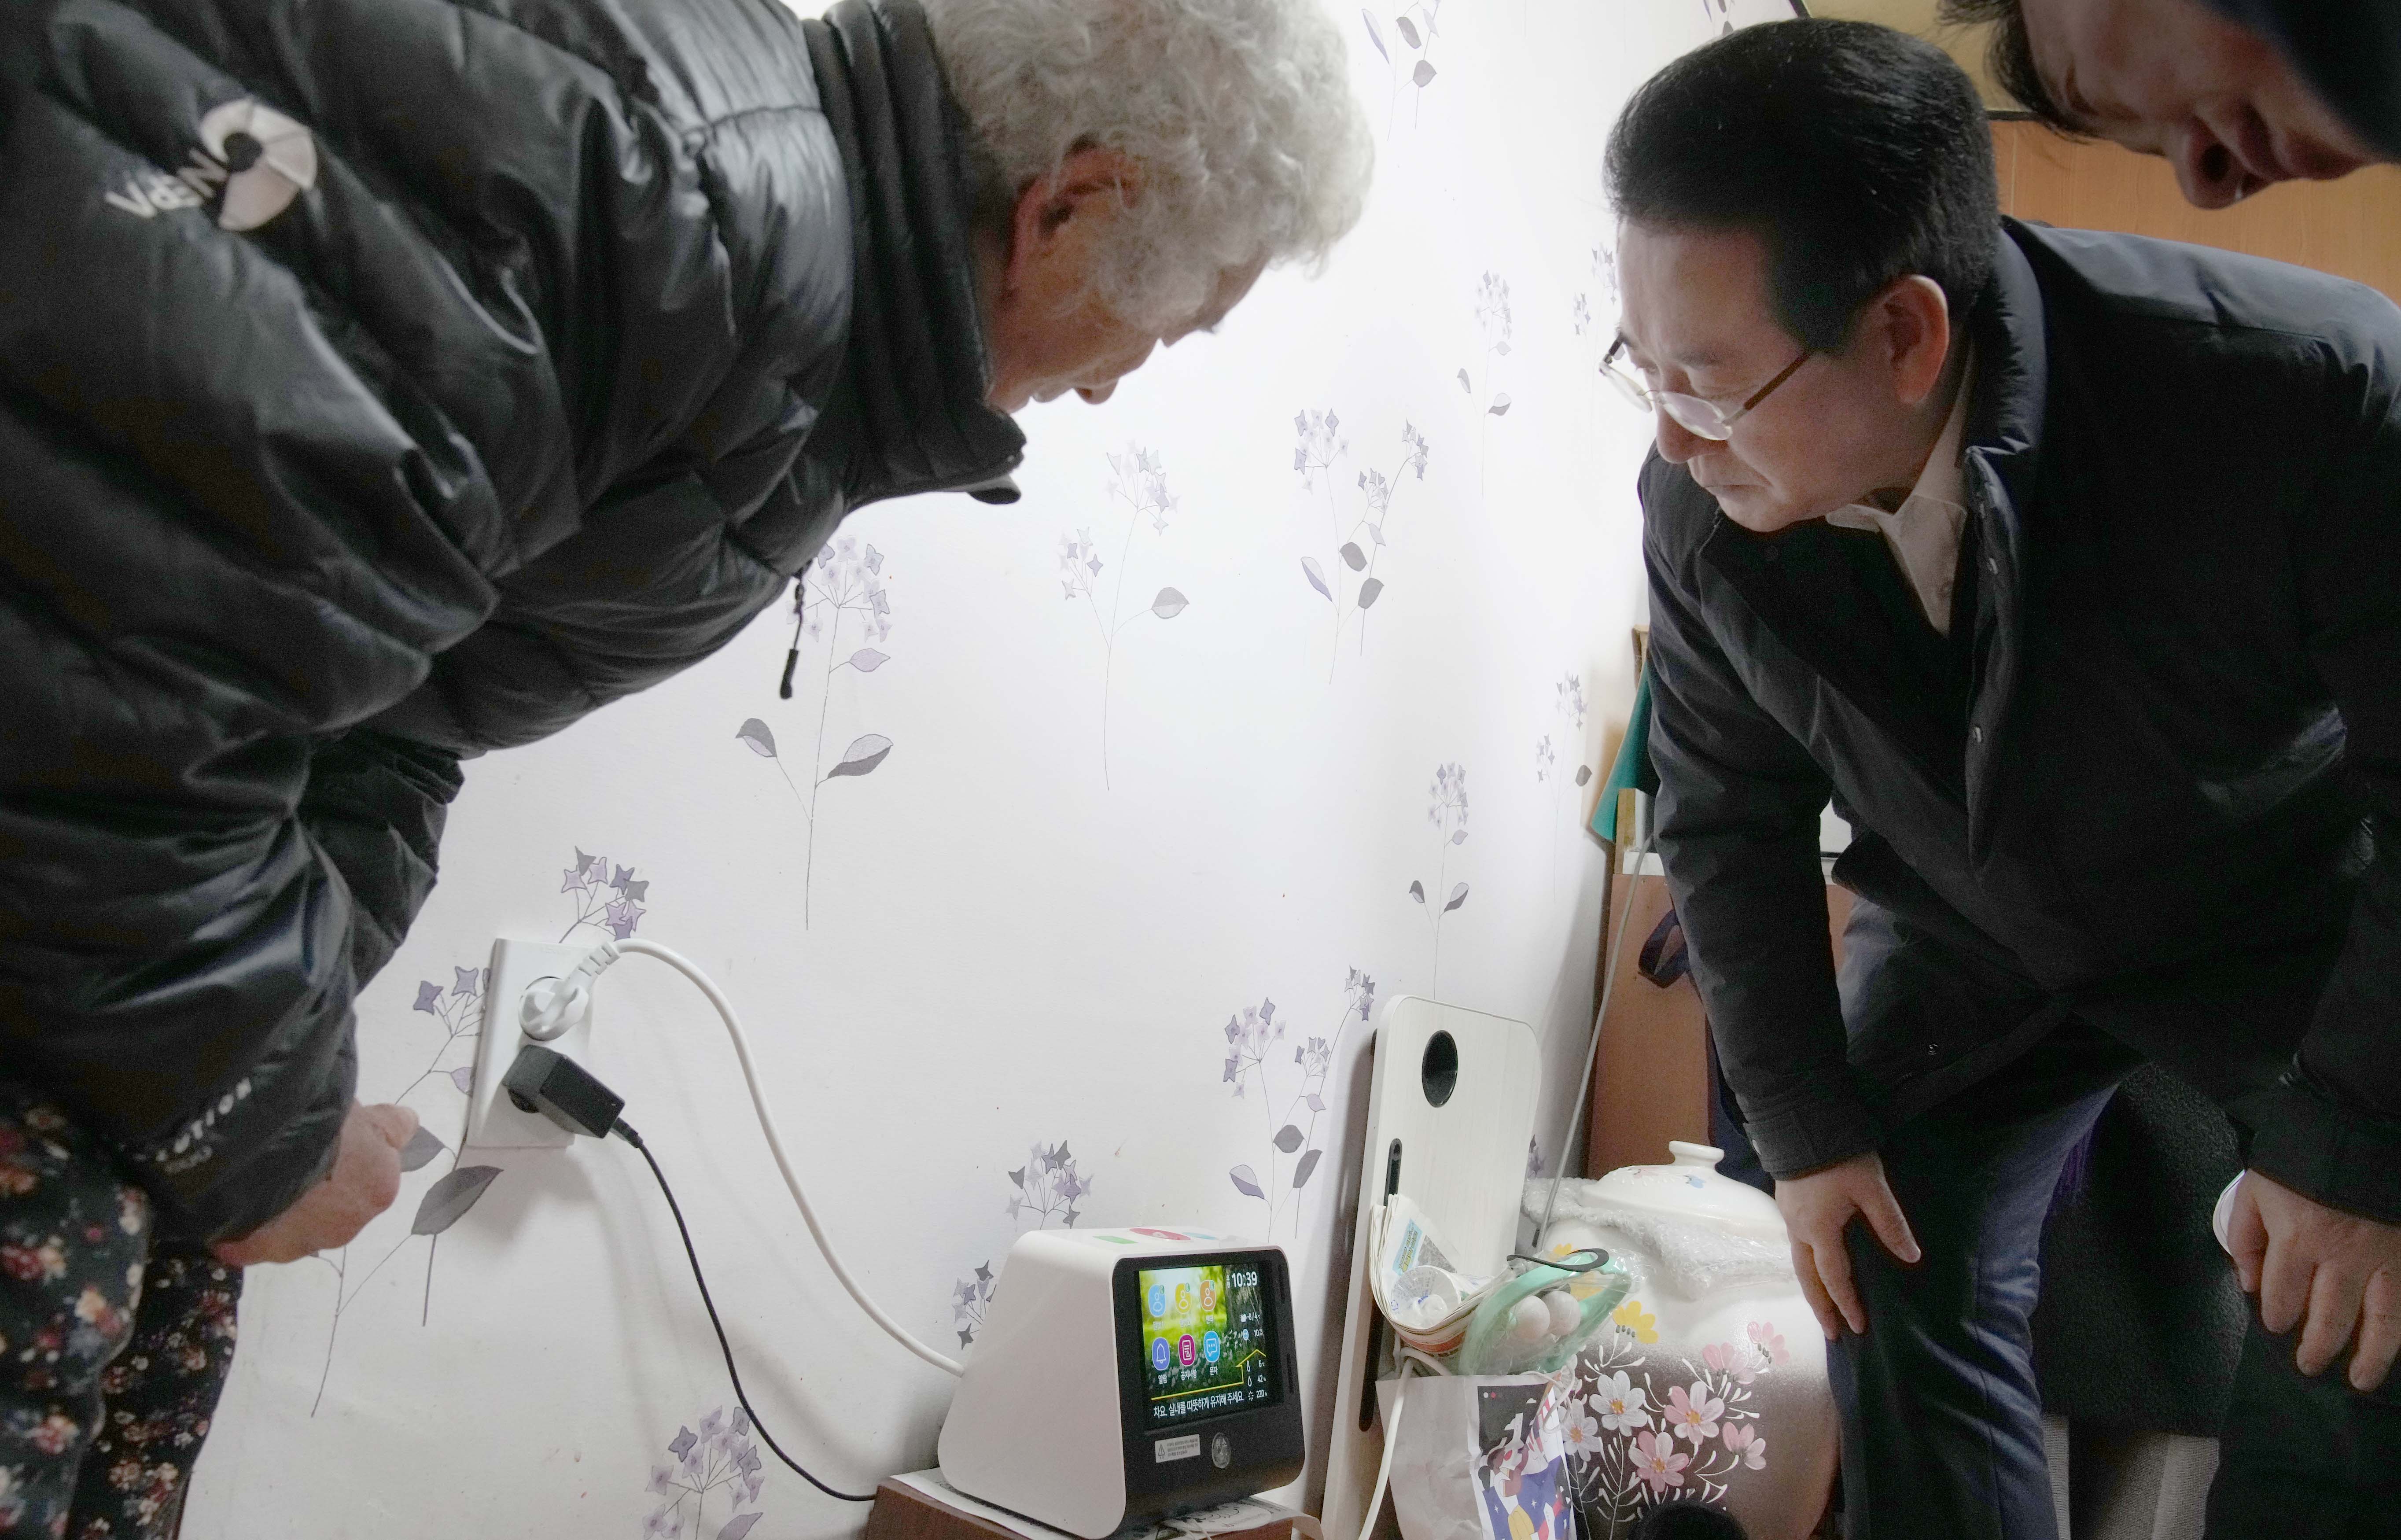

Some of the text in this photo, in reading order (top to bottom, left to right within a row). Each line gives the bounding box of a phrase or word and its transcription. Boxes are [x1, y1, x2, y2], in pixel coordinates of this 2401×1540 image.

[1232, 1271, 1258, 1287] 10:39
[1180, 1370, 1197, 1381] 공지사항
[1209, 1366, 1218, 1375] 문자
[1158, 1374, 1167, 1385] 알람
[1168, 1401, 1186, 1417] 실내를
[1186, 1397, 1210, 1412] 따뜻하게
[1210, 1393, 1227, 1408] 유지해
